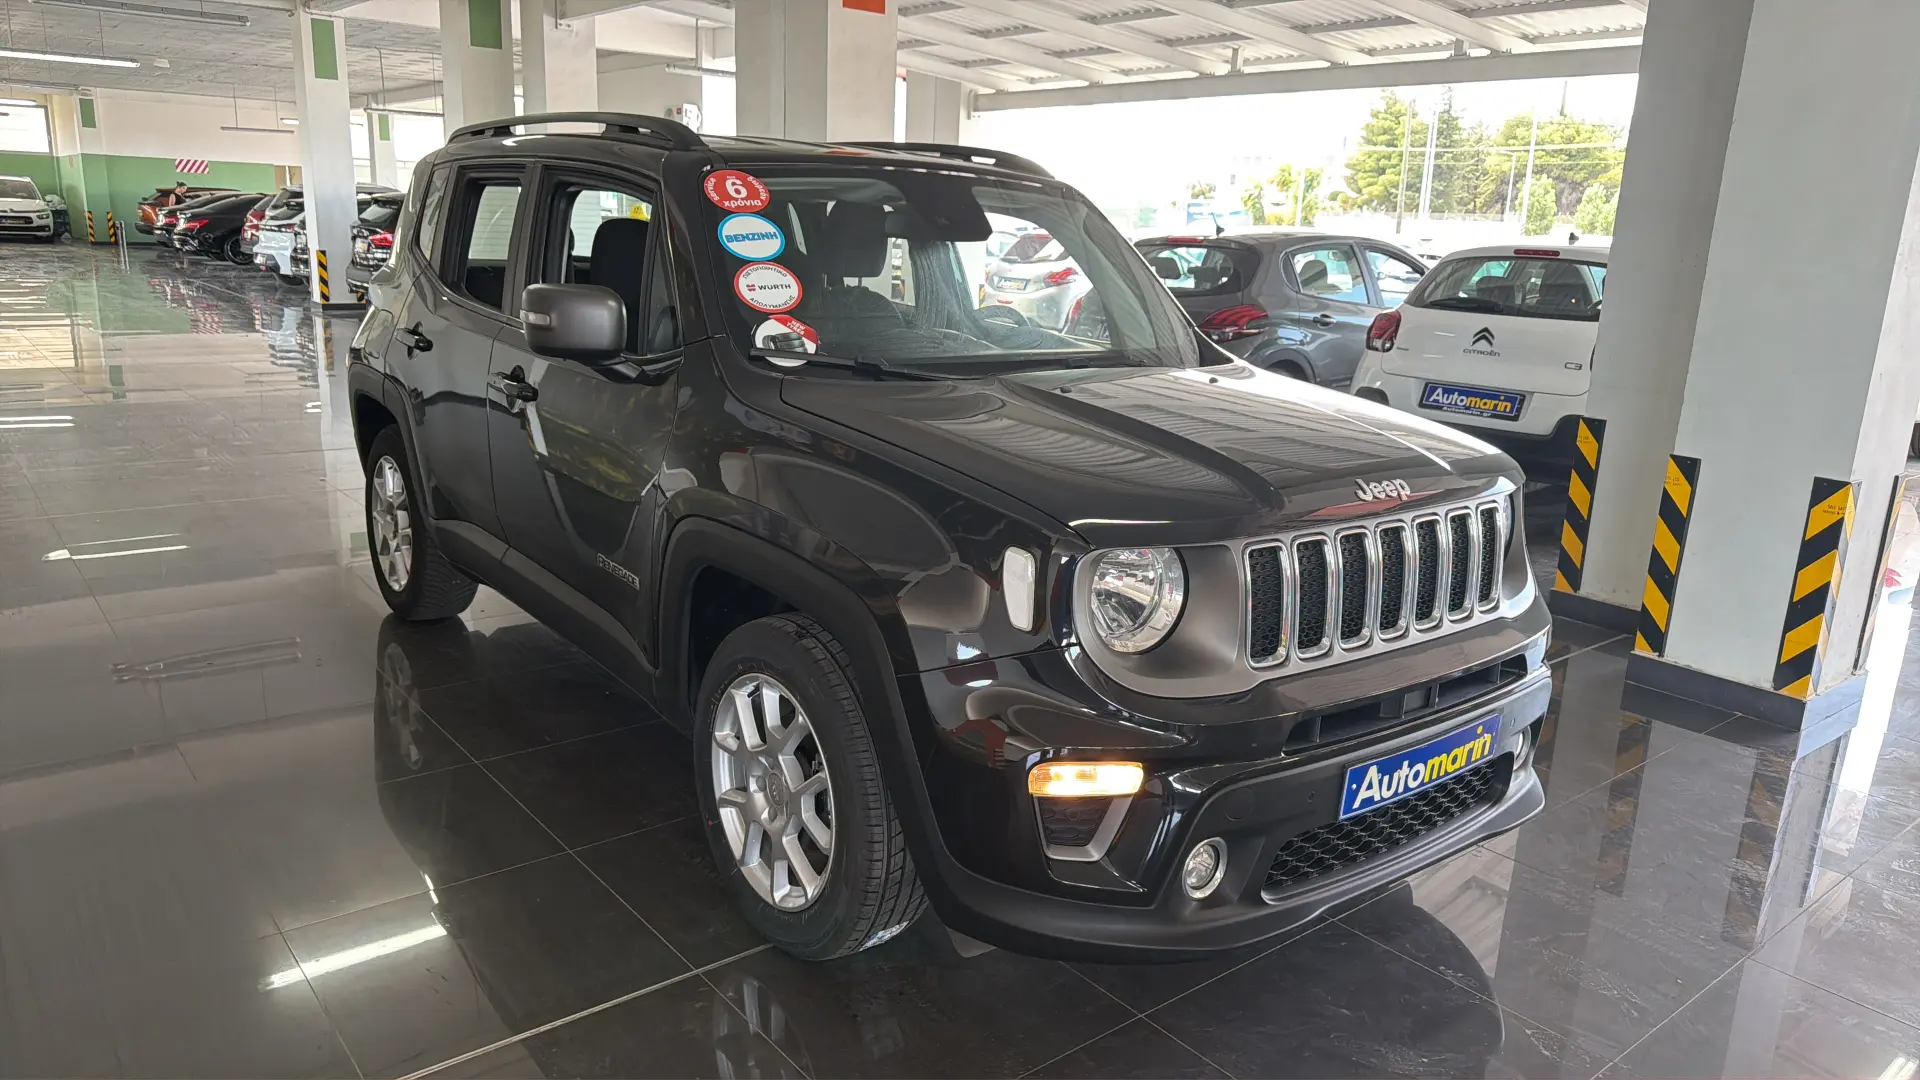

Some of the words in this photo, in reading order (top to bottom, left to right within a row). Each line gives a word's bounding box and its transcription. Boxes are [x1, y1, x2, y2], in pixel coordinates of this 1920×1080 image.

[707, 177, 720, 201] service
[725, 178, 748, 199] 6
[722, 199, 762, 208] χρόνια
[724, 231, 779, 243] ΒΕΝΖΙΝΗ
[786, 321, 805, 335] TYRES
[791, 320, 806, 330] NEW
[1429, 387, 1512, 413] Automarin
[1355, 478, 1411, 501] Jeep
[1352, 725, 1492, 809] Automarin
